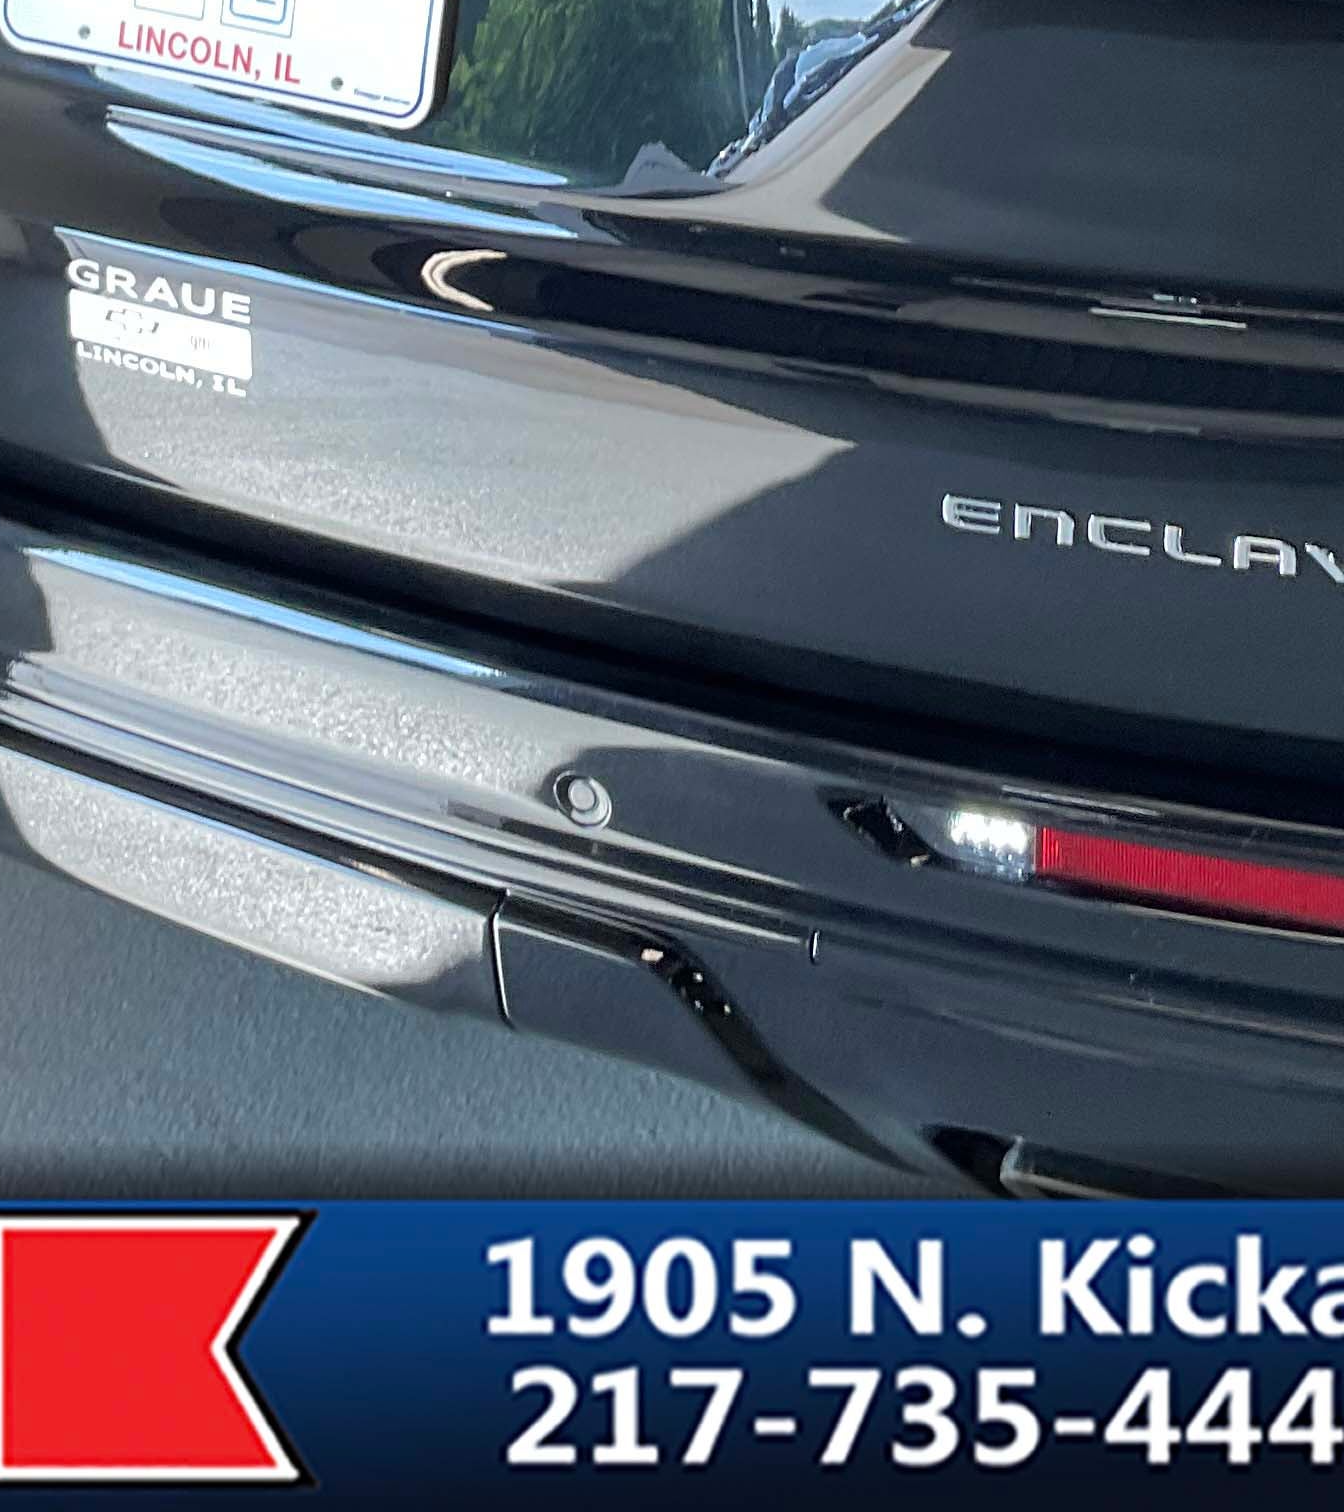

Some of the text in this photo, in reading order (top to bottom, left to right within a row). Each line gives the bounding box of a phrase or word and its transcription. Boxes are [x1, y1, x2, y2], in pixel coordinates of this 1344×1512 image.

[117, 21, 301, 85] LINCOLN, IL
[67, 257, 252, 325] GRAUE
[76, 340, 247, 398] LINCOLN, IL
